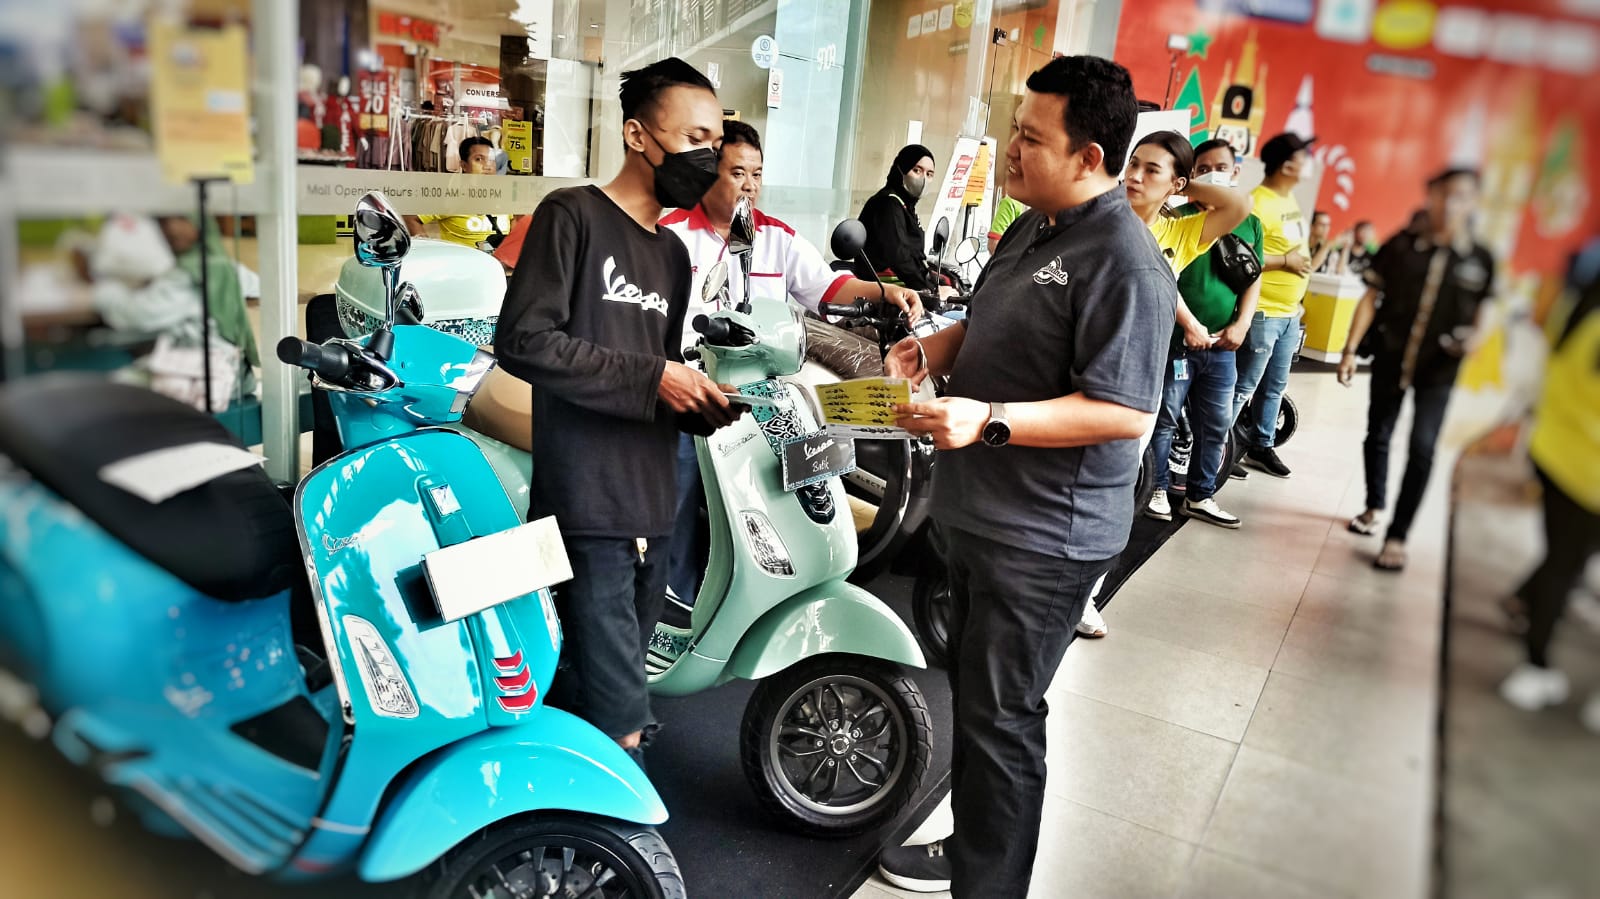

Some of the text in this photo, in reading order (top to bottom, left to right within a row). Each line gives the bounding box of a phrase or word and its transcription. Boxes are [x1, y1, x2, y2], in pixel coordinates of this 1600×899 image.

[307, 184, 331, 195] Mall
[383, 186, 413, 197] Hours
[444, 188, 460, 198] AM
[489, 188, 502, 198] PM
[803, 438, 835, 461] Vespa
